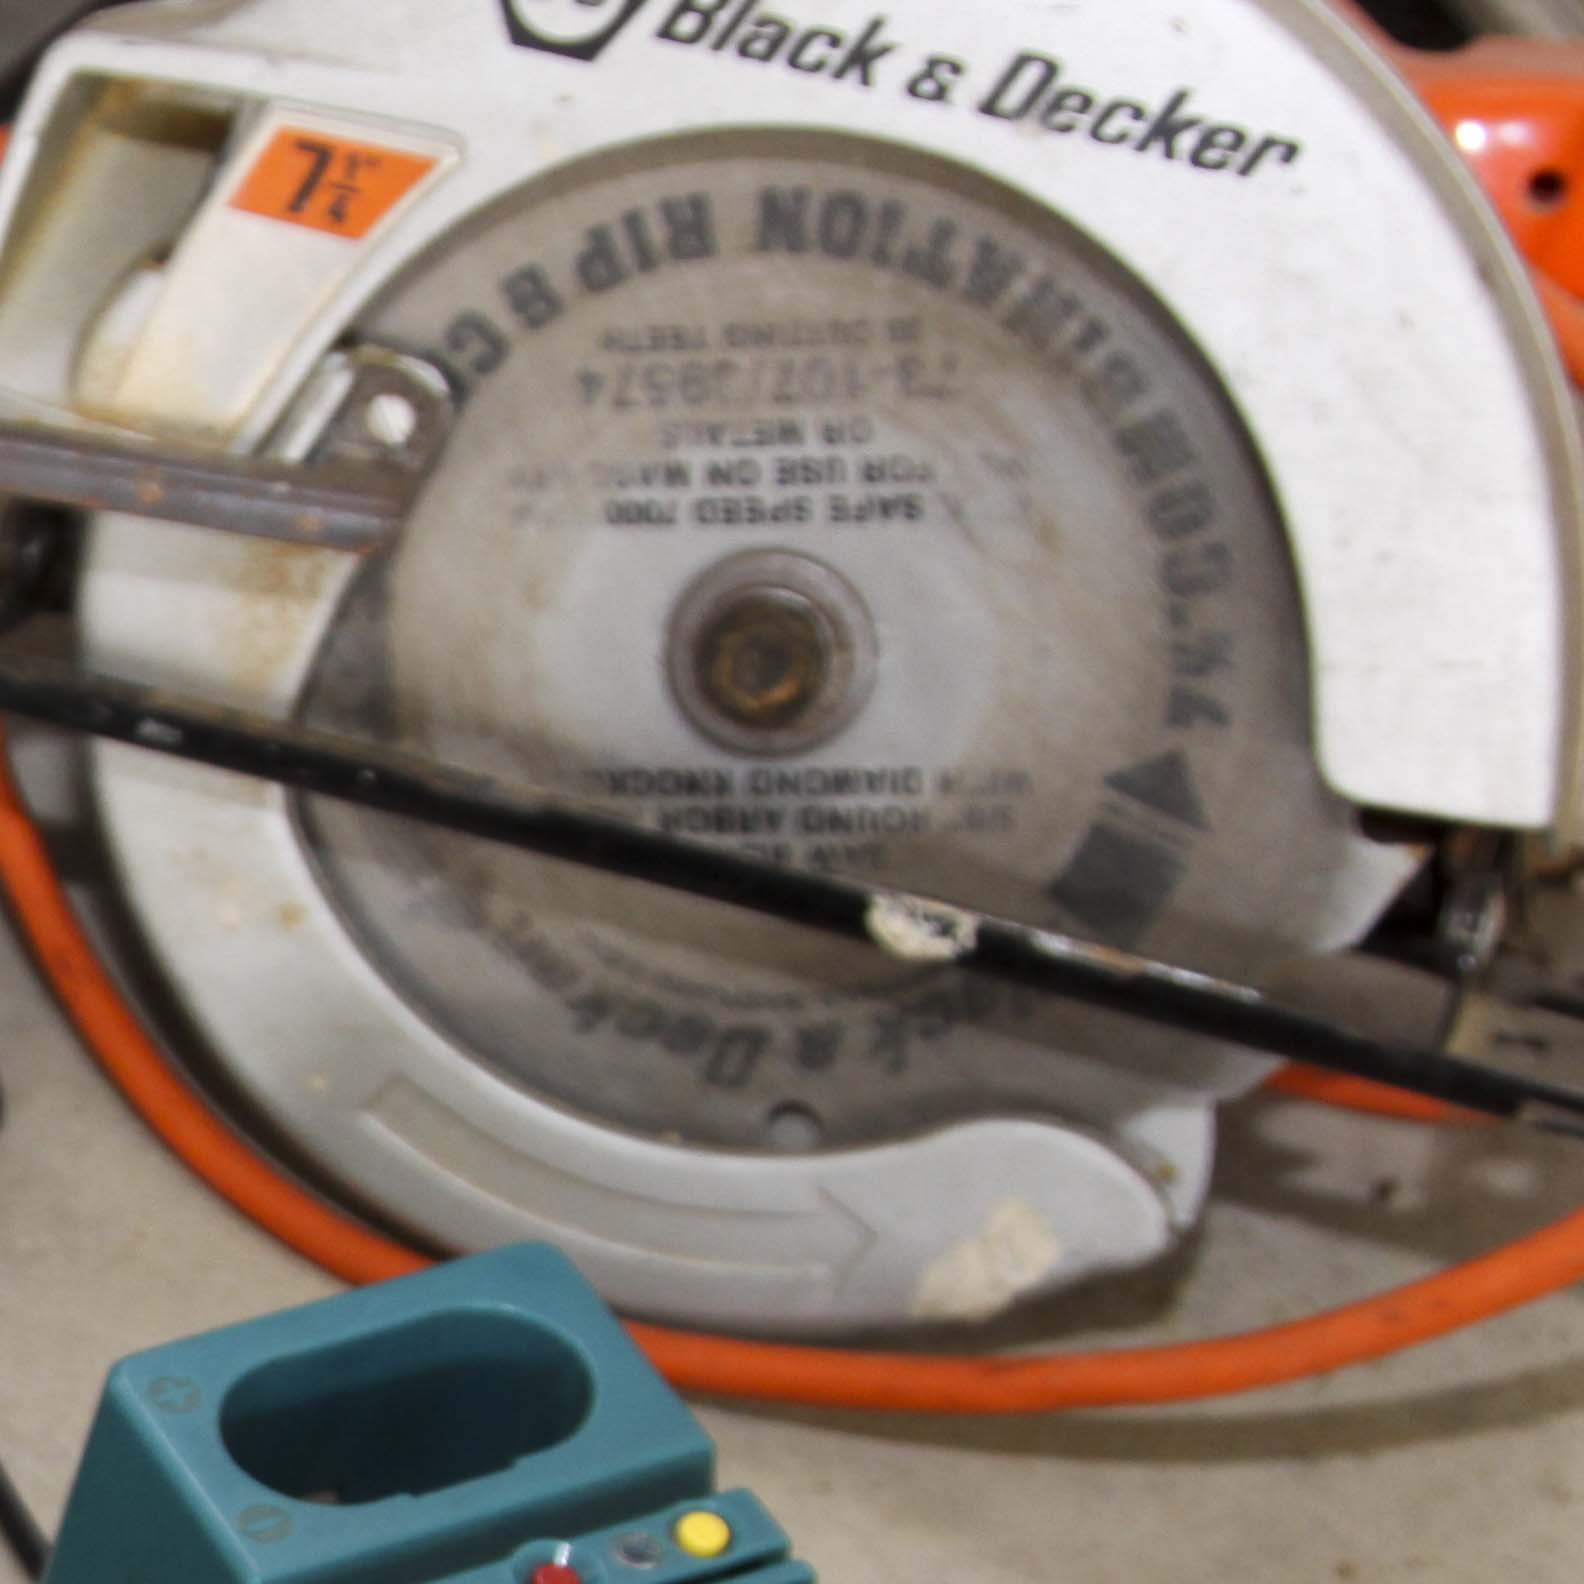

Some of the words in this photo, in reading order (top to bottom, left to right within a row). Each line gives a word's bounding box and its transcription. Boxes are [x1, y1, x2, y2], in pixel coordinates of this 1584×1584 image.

[654, 0, 899, 89] Black
[906, 57, 962, 105] &
[978, 52, 1303, 181] Decker
[574, 191, 716, 294] RIP
[706, 458, 762, 489] ON
[775, 456, 847, 488] USE
[860, 456, 934, 485] FOR
[692, 496, 814, 528] SPEED
[830, 493, 926, 526] SAFE
